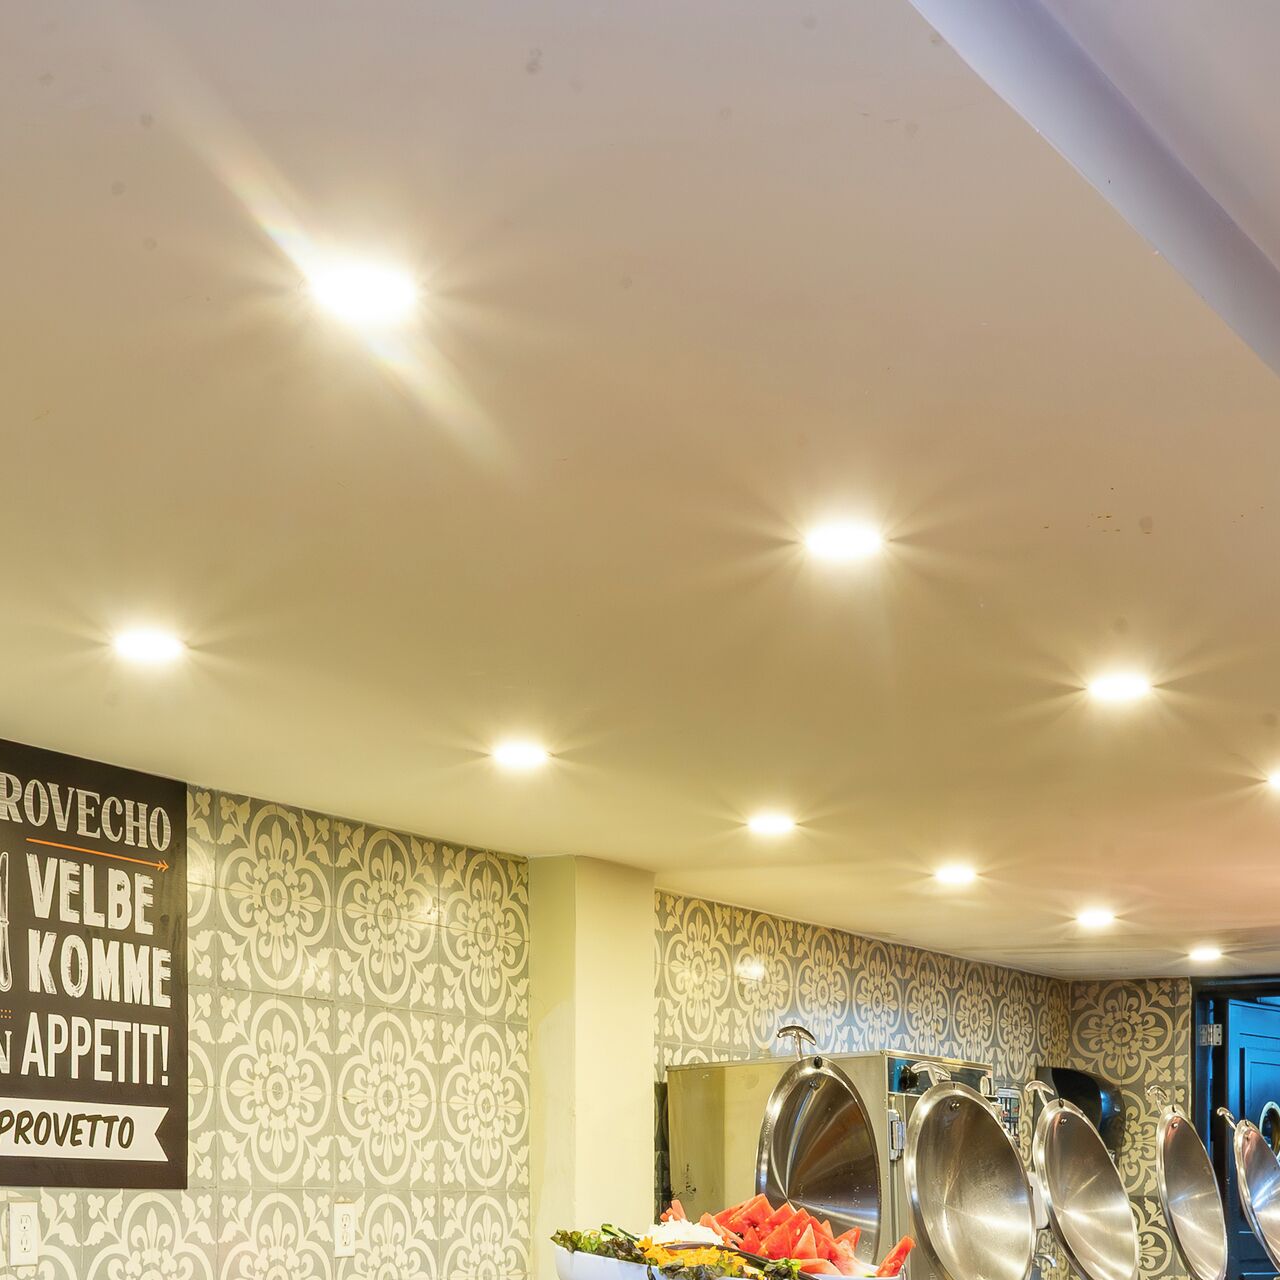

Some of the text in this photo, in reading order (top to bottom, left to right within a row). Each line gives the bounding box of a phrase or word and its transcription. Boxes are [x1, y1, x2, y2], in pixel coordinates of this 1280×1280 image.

[26, 853, 154, 935] VELBE
[27, 929, 171, 1008] KOMME
[21, 1012, 169, 1086] APPETIT!
